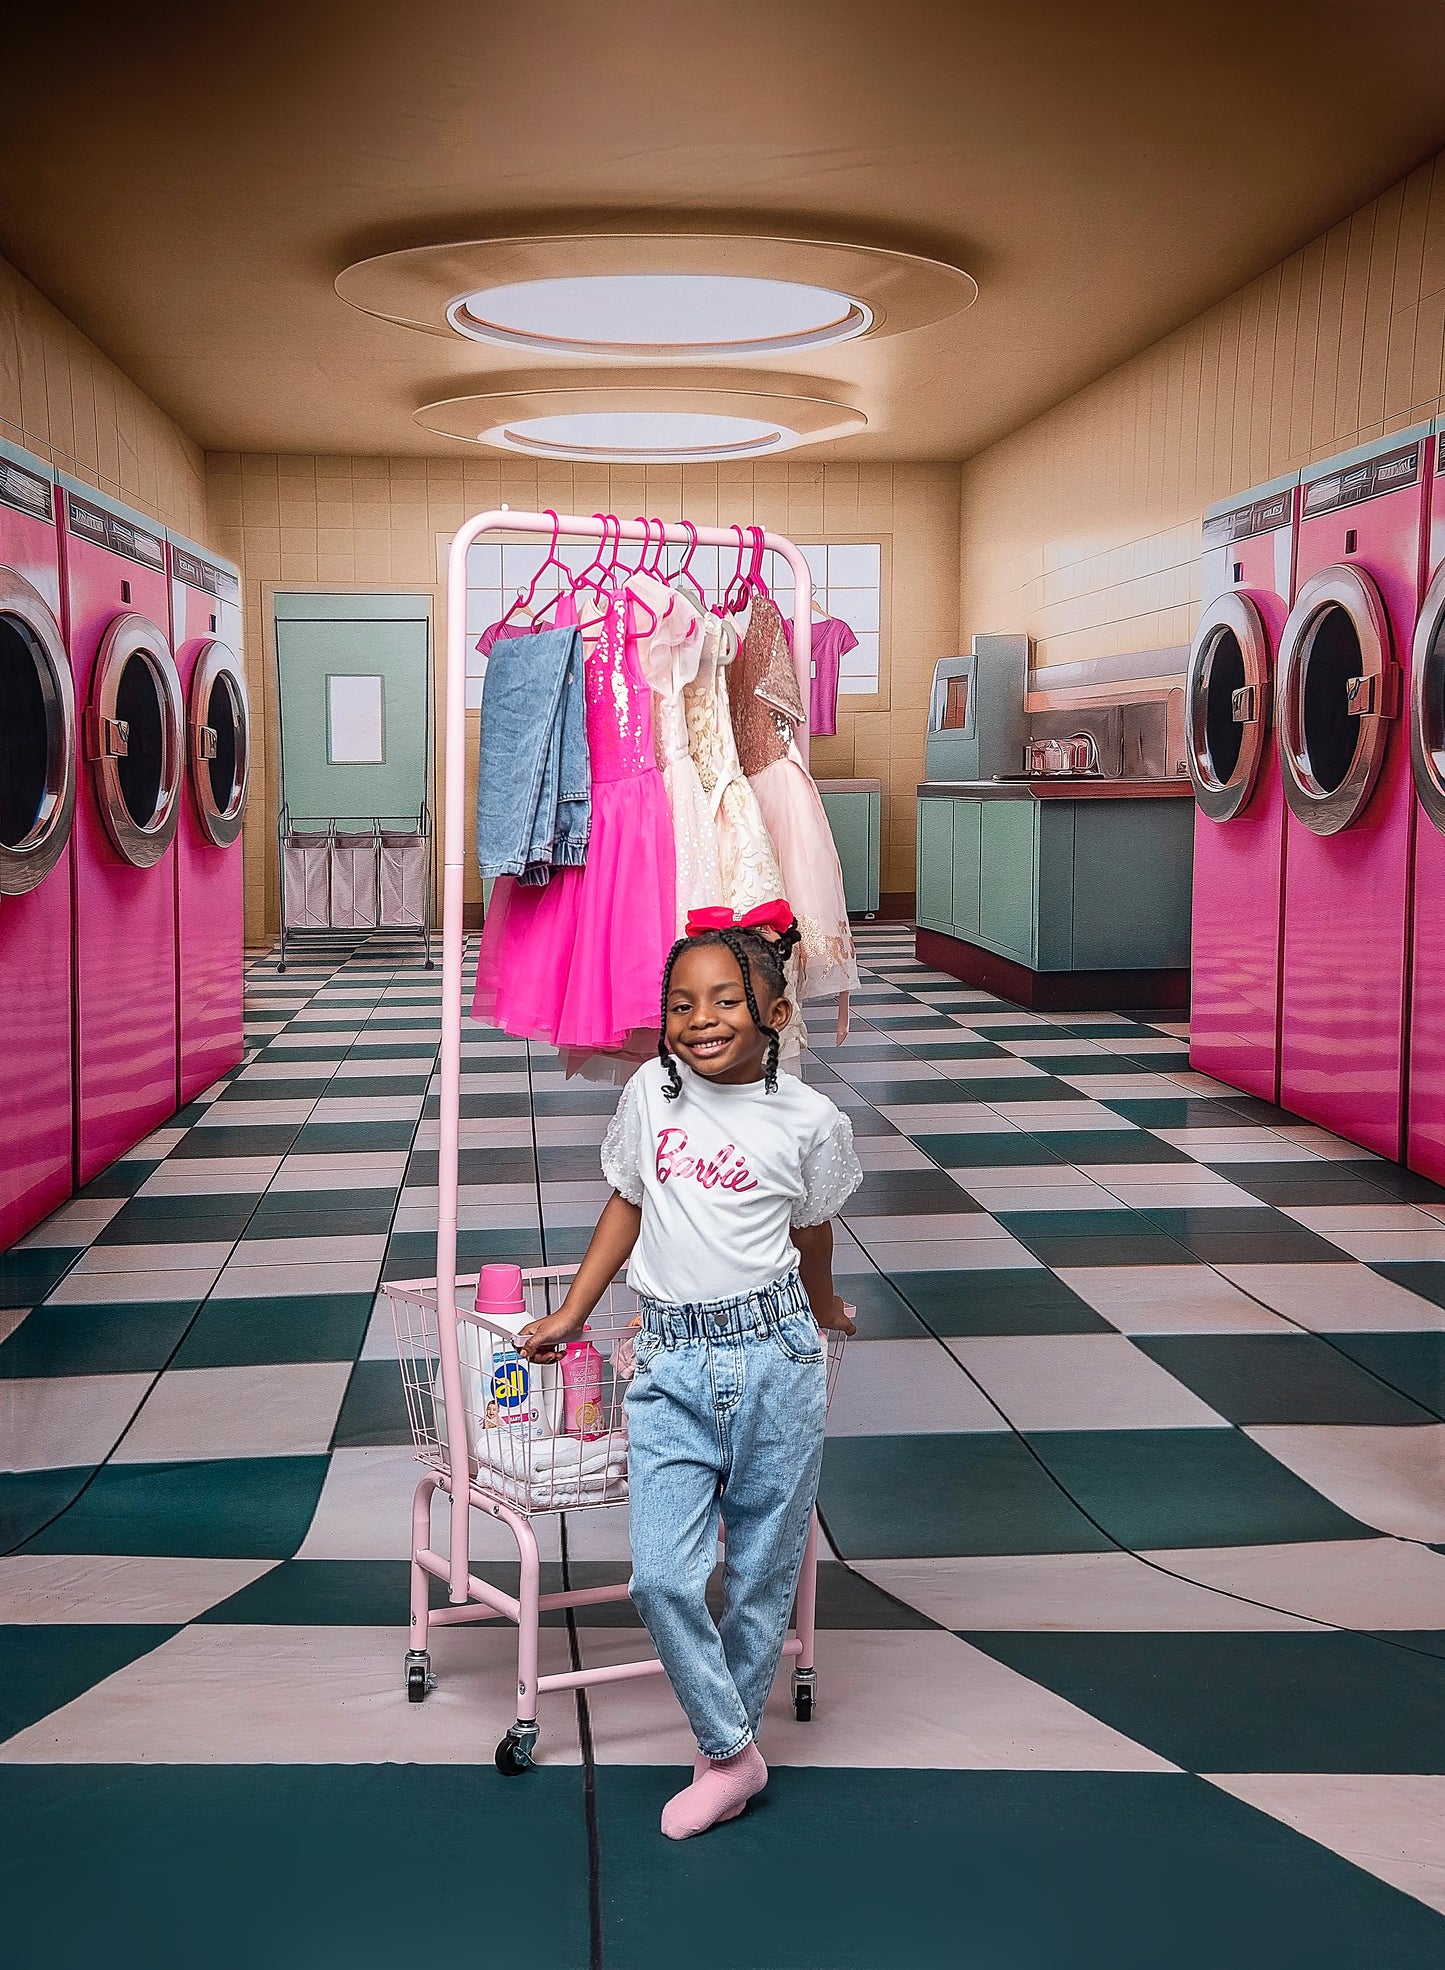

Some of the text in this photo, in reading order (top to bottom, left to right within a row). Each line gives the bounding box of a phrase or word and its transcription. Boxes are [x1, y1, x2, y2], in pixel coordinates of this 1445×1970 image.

[656, 1128, 758, 1192] Barbie
[495, 1370, 524, 1398] all
[573, 1374, 597, 1383] BOOTER
